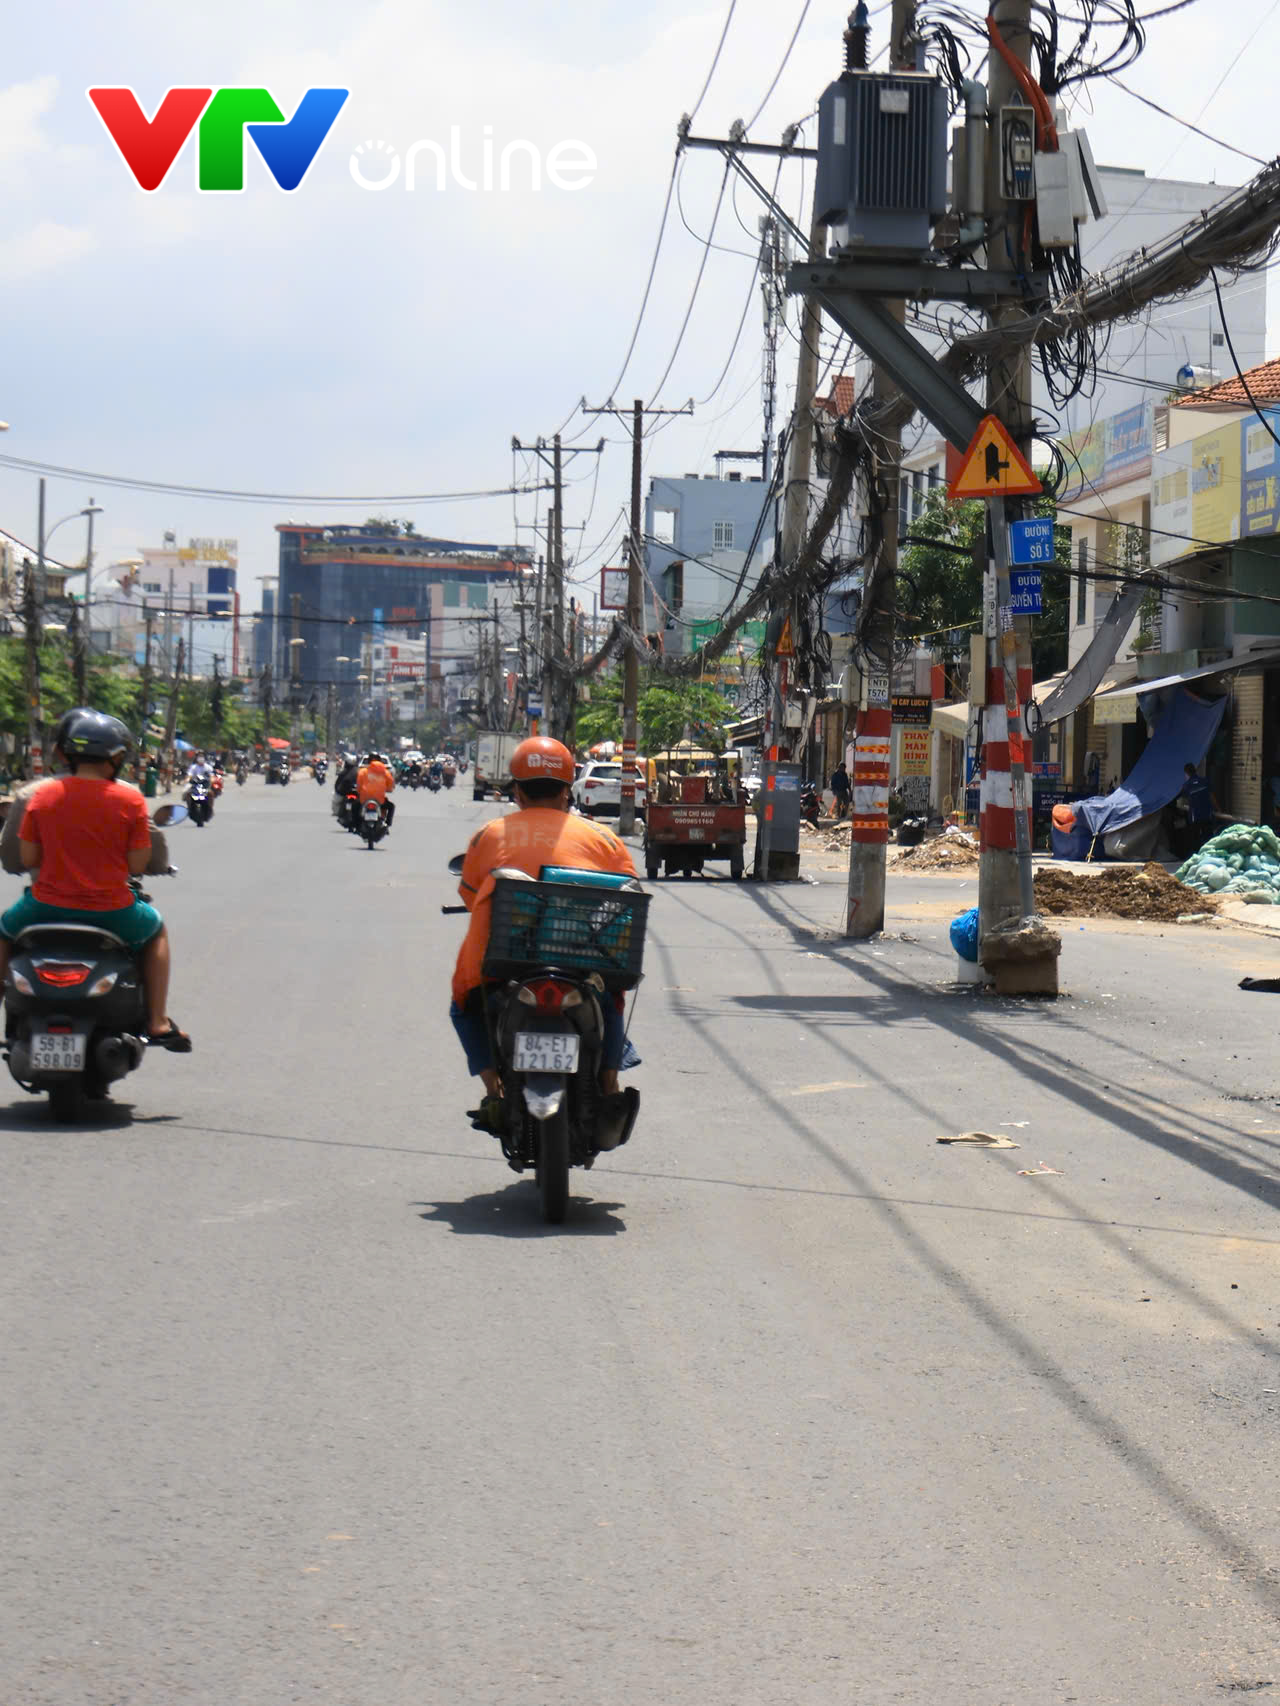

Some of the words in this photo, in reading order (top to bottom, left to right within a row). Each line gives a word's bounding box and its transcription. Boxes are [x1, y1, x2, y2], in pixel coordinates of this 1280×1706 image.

[1030, 538, 1043, 559] SỐ
[1044, 543, 1050, 557] 5
[1017, 574, 1041, 586] ĐƯỜN
[903, 732, 929, 740] THAY
[525, 1035, 567, 1053] 84-E1
[519, 1053, 574, 1071] 121.62
